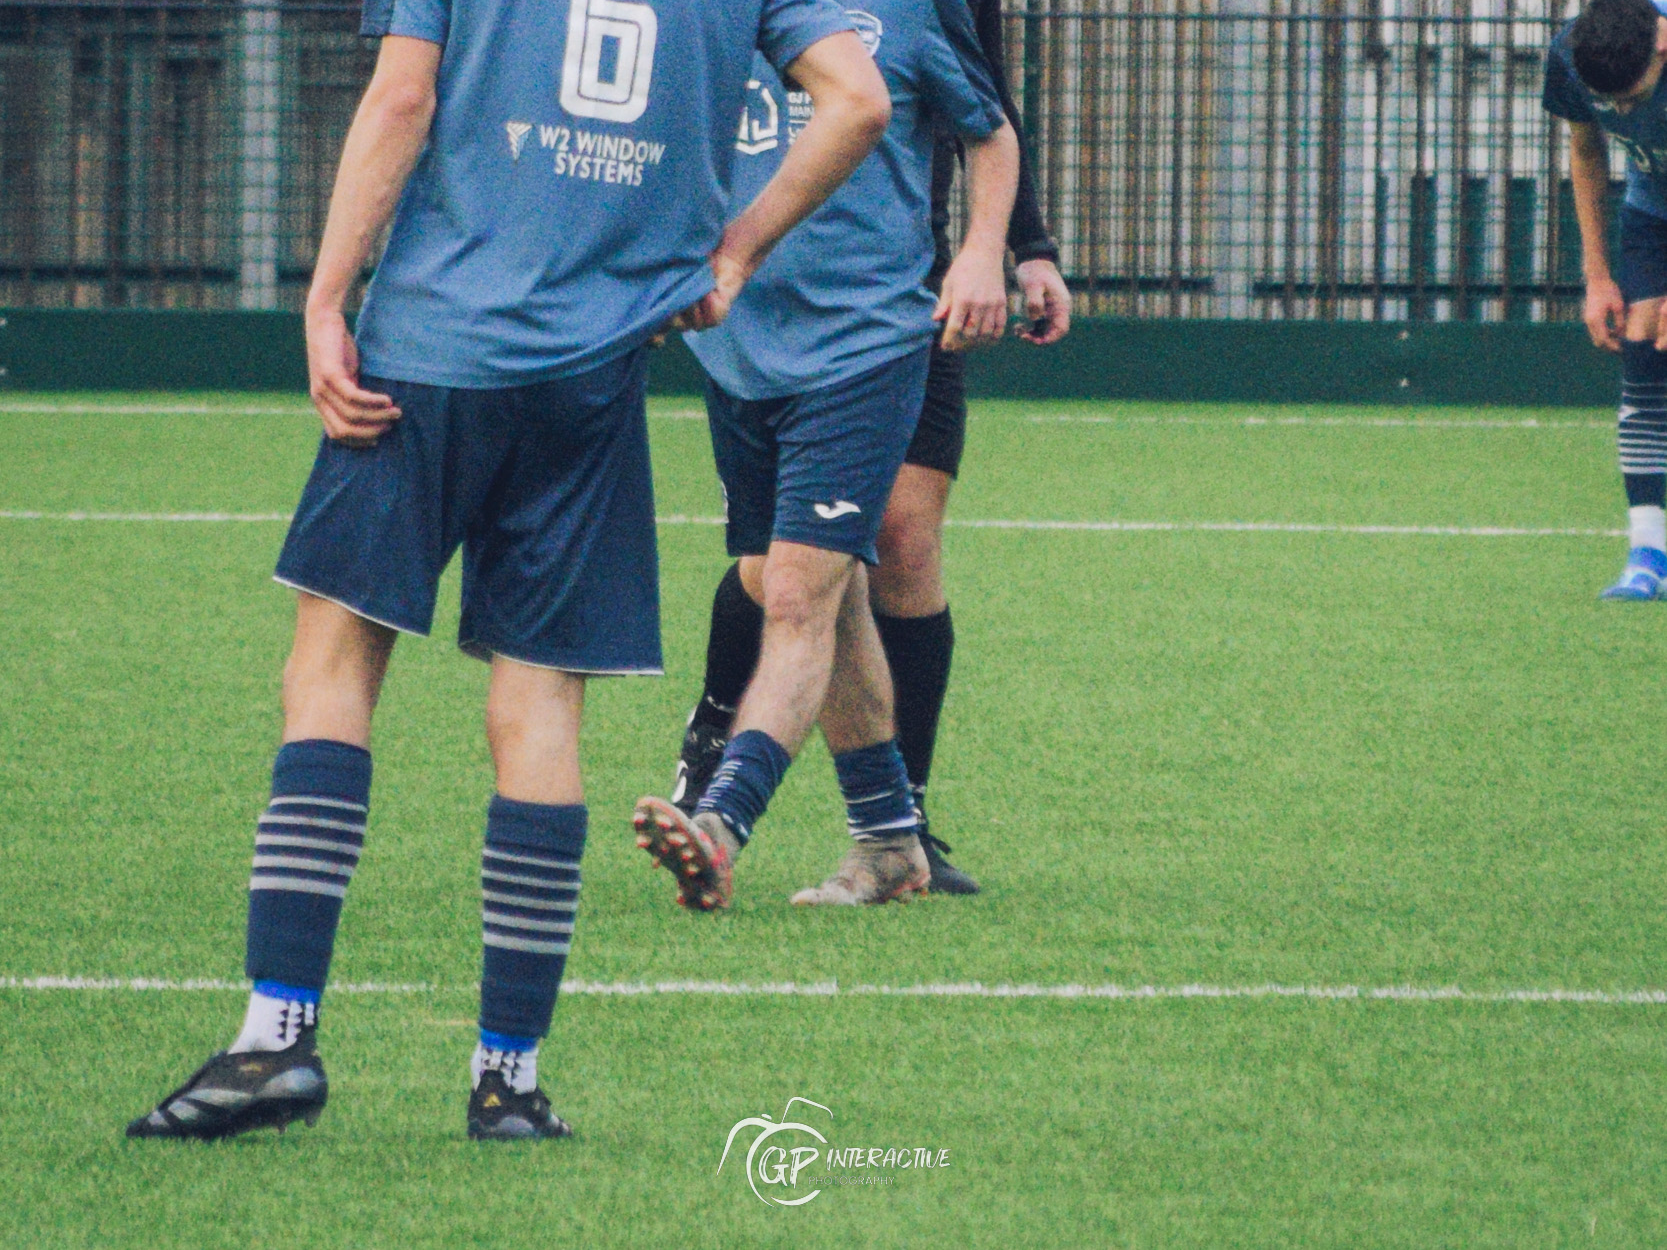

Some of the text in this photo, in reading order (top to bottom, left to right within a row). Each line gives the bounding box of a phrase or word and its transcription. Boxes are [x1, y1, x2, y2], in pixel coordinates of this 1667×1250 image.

[540, 125, 665, 165] W2 WINDOW
[555, 152, 642, 186] SYSTEMS
